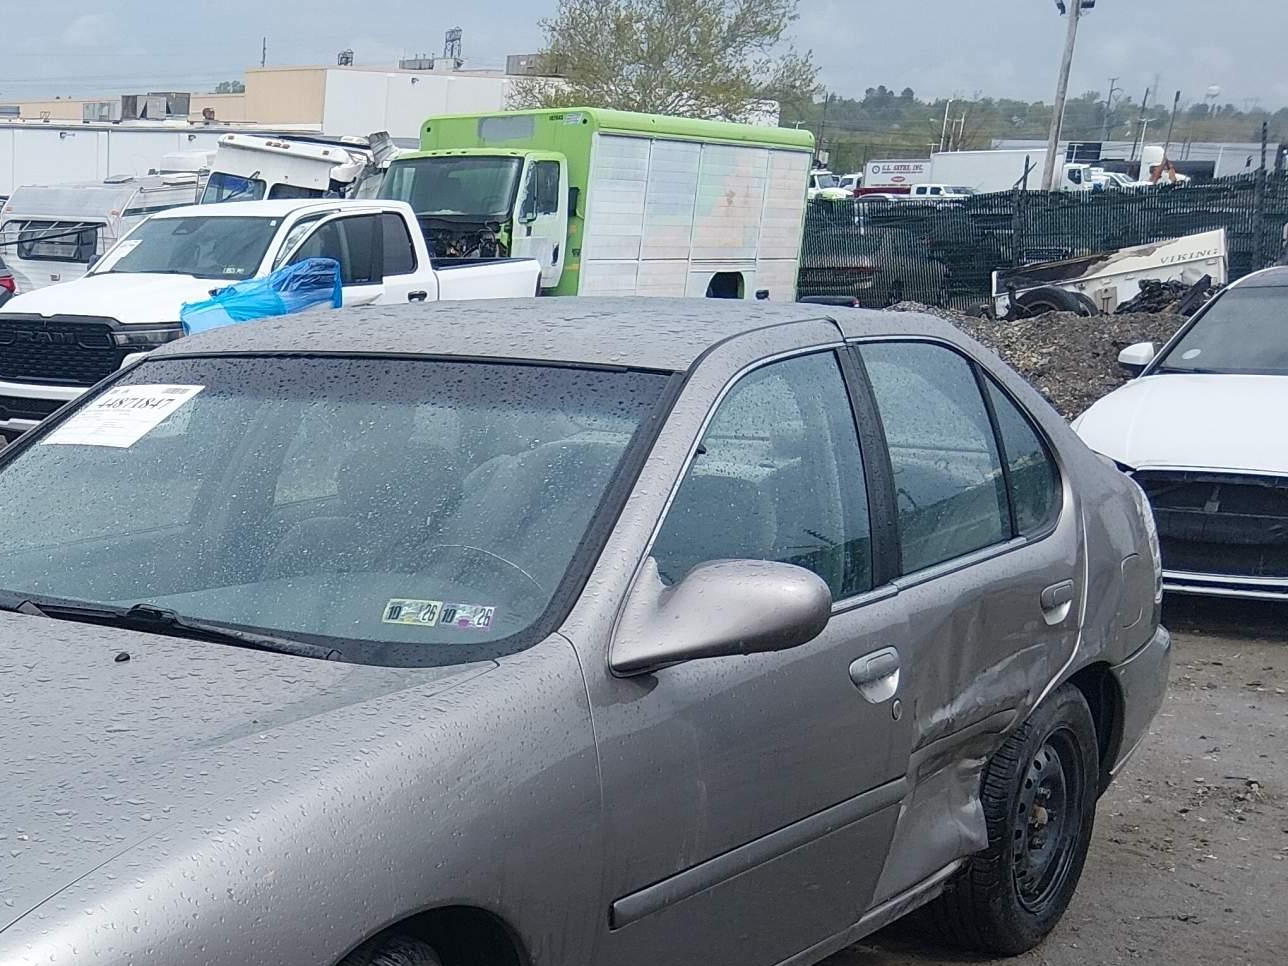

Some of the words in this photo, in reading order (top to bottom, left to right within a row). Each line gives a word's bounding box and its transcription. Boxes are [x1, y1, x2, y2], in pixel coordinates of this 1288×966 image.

[1161, 248, 1218, 264] VIKING
[15, 331, 75, 345] RAM
[96, 397, 177, 409] 44871847
[387, 605, 402, 620] 10
[421, 604, 438, 622] 26
[441, 608, 456, 624] 10
[477, 608, 493, 627] 26
